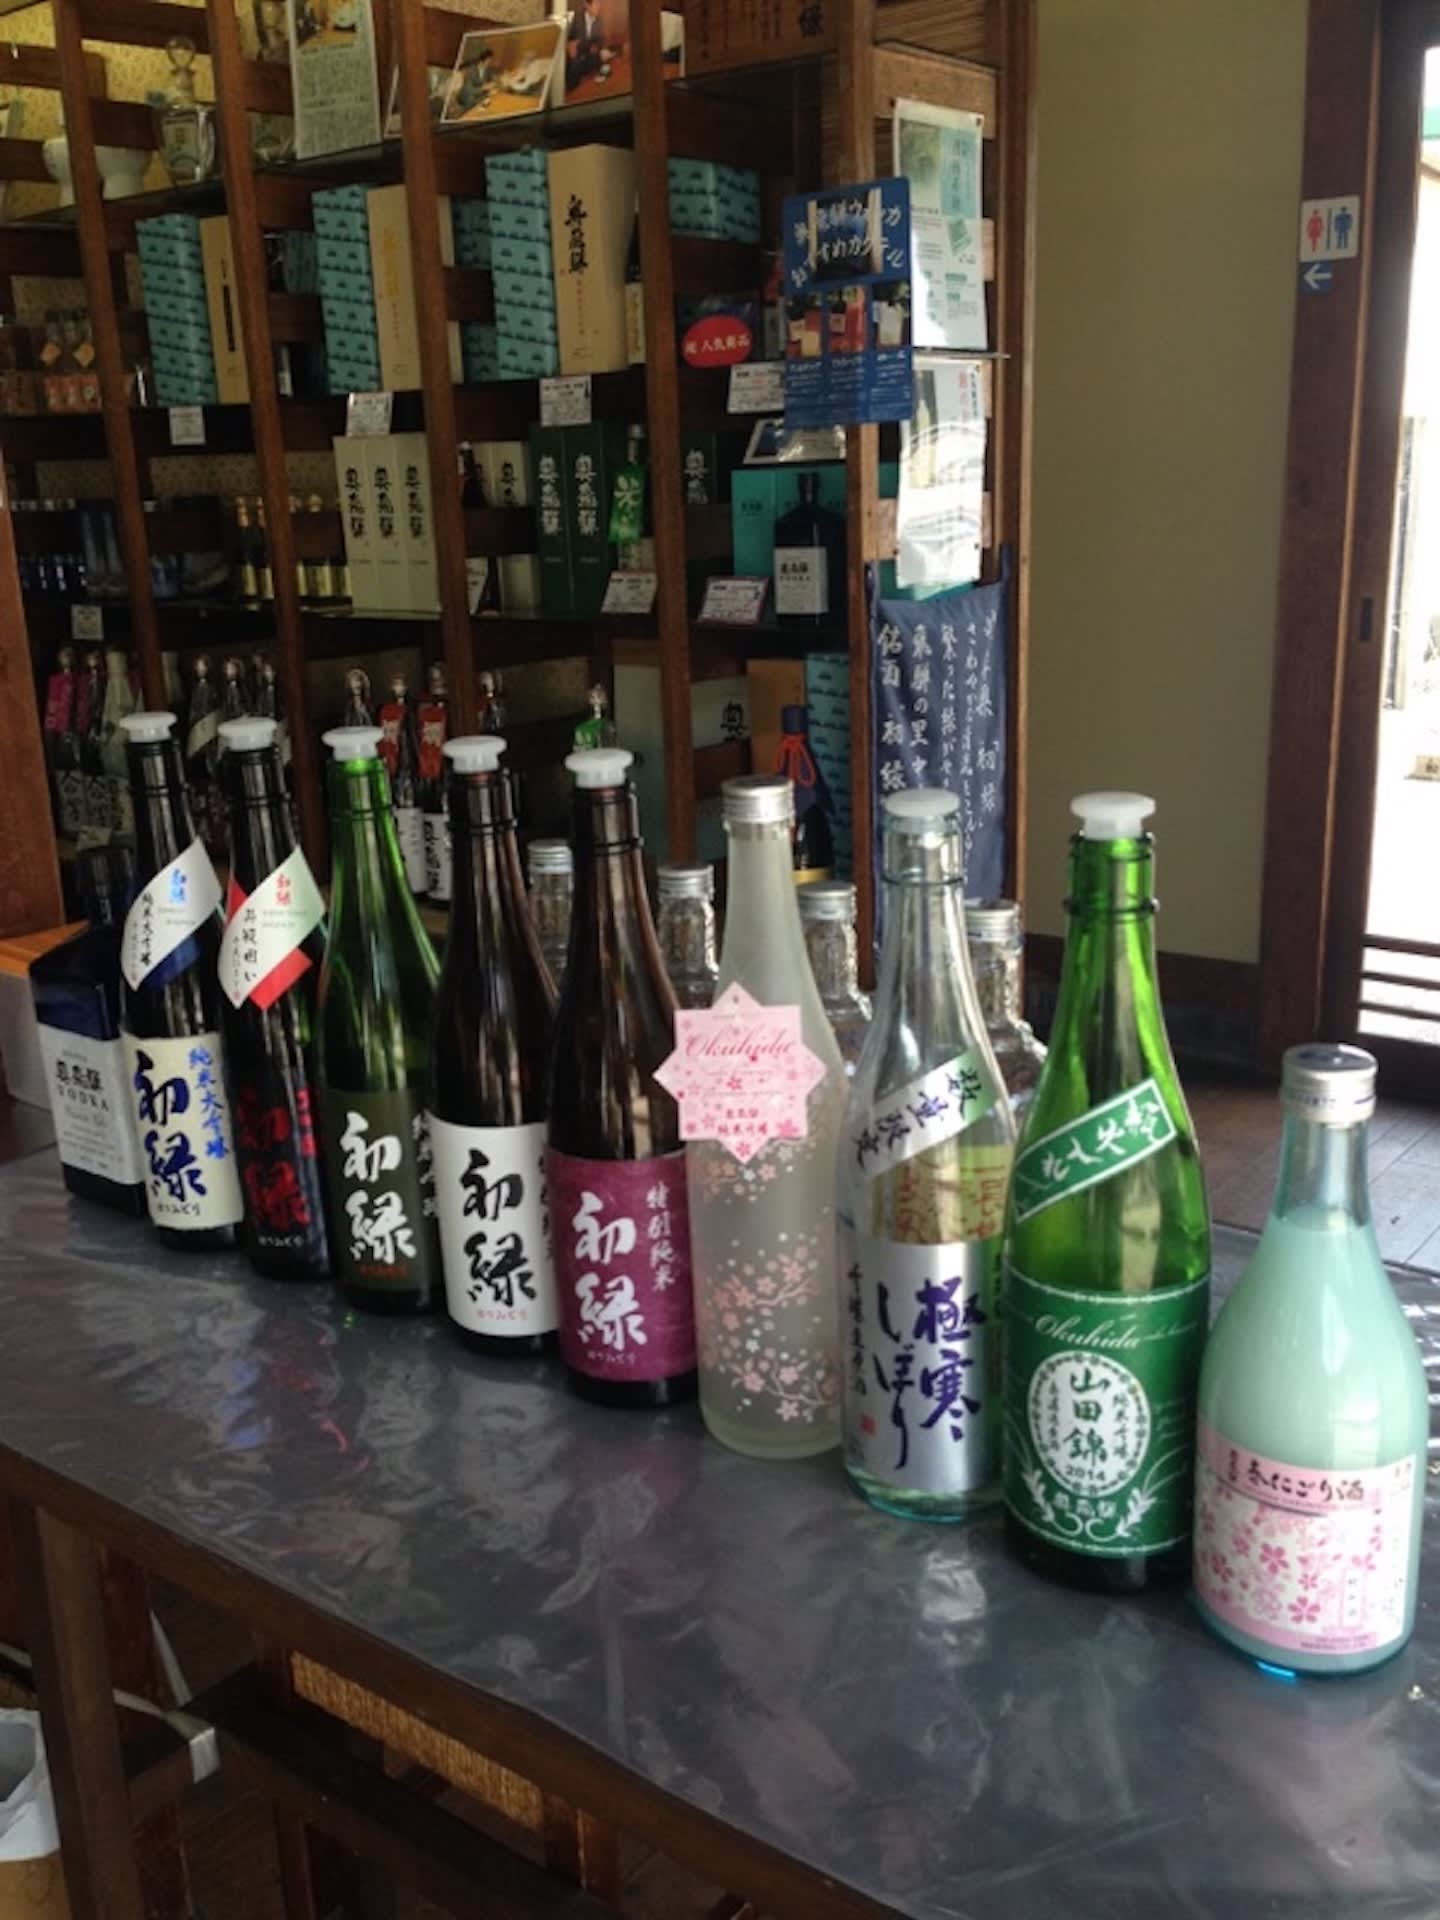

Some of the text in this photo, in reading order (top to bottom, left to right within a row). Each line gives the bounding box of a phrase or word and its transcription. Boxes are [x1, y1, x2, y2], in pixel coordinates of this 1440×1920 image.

[685, 1026, 795, 1057] Okuhida
[134, 1050, 208, 1203] 初緑
[338, 1111, 417, 1265] 初緑
[460, 1148, 537, 1308] 初緑
[571, 1191, 648, 1352] 初緑
[644, 1180, 678, 1292] 特別純米
[872, 1281, 915, 1471] しぼり
[1034, 1314, 1141, 1349] Okuhida
[1064, 1367, 1111, 1467] 山田錦
[1065, 1465, 1107, 1483] 2014
